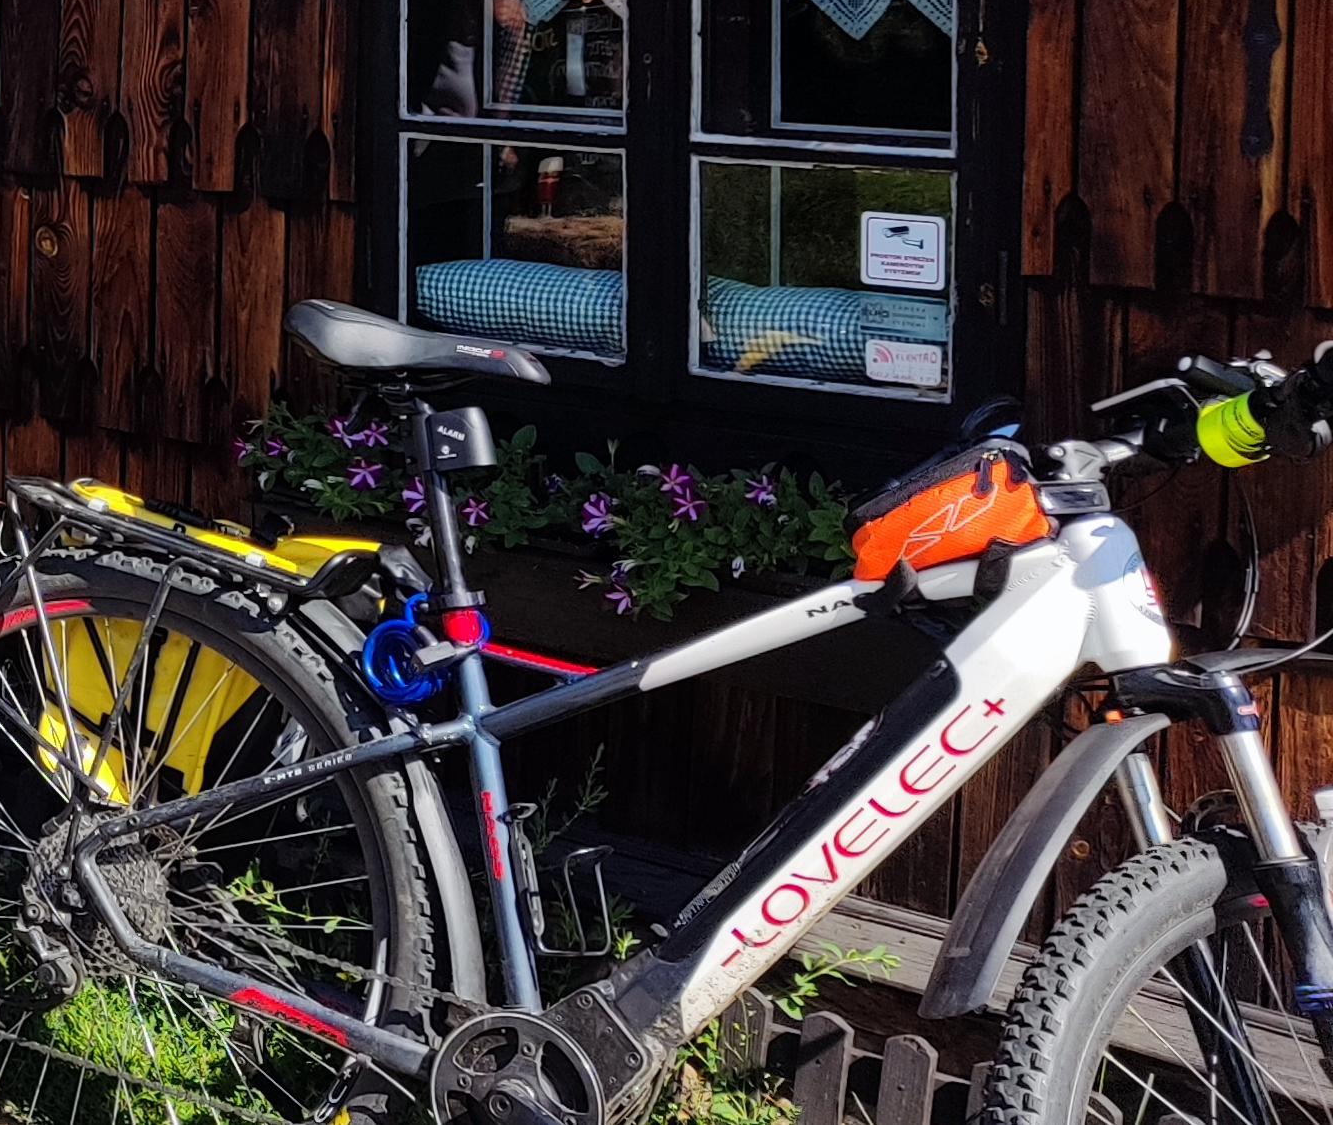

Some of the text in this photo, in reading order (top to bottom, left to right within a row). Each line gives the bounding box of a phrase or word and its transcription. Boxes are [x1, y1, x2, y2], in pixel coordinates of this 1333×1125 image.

[437, 425, 466, 441] ALARM
[263, 753, 353, 784] E-MTB SERIES
